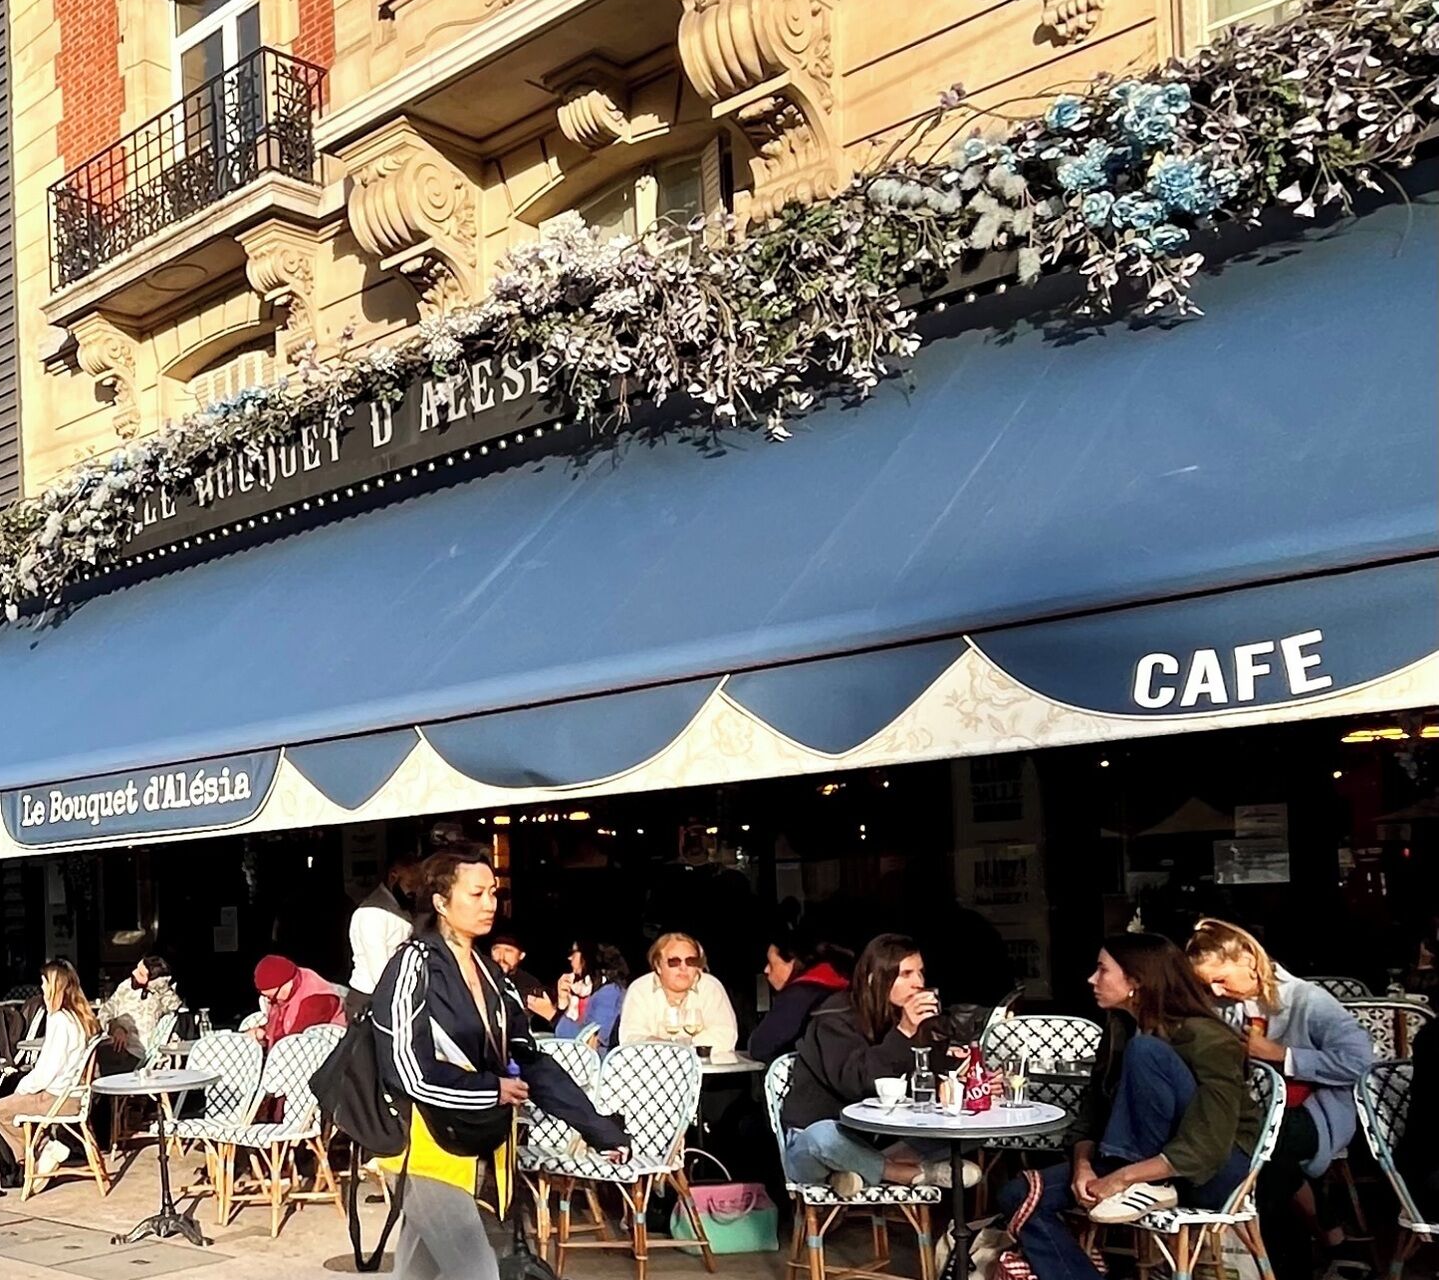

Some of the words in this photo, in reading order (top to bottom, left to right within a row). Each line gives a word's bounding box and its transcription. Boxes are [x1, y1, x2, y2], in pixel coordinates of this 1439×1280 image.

[1132, 628, 1334, 710] CAFE
[20, 793, 46, 827] Le
[48, 779, 139, 826] Bouquet
[143, 766, 252, 813] d'Alésia
